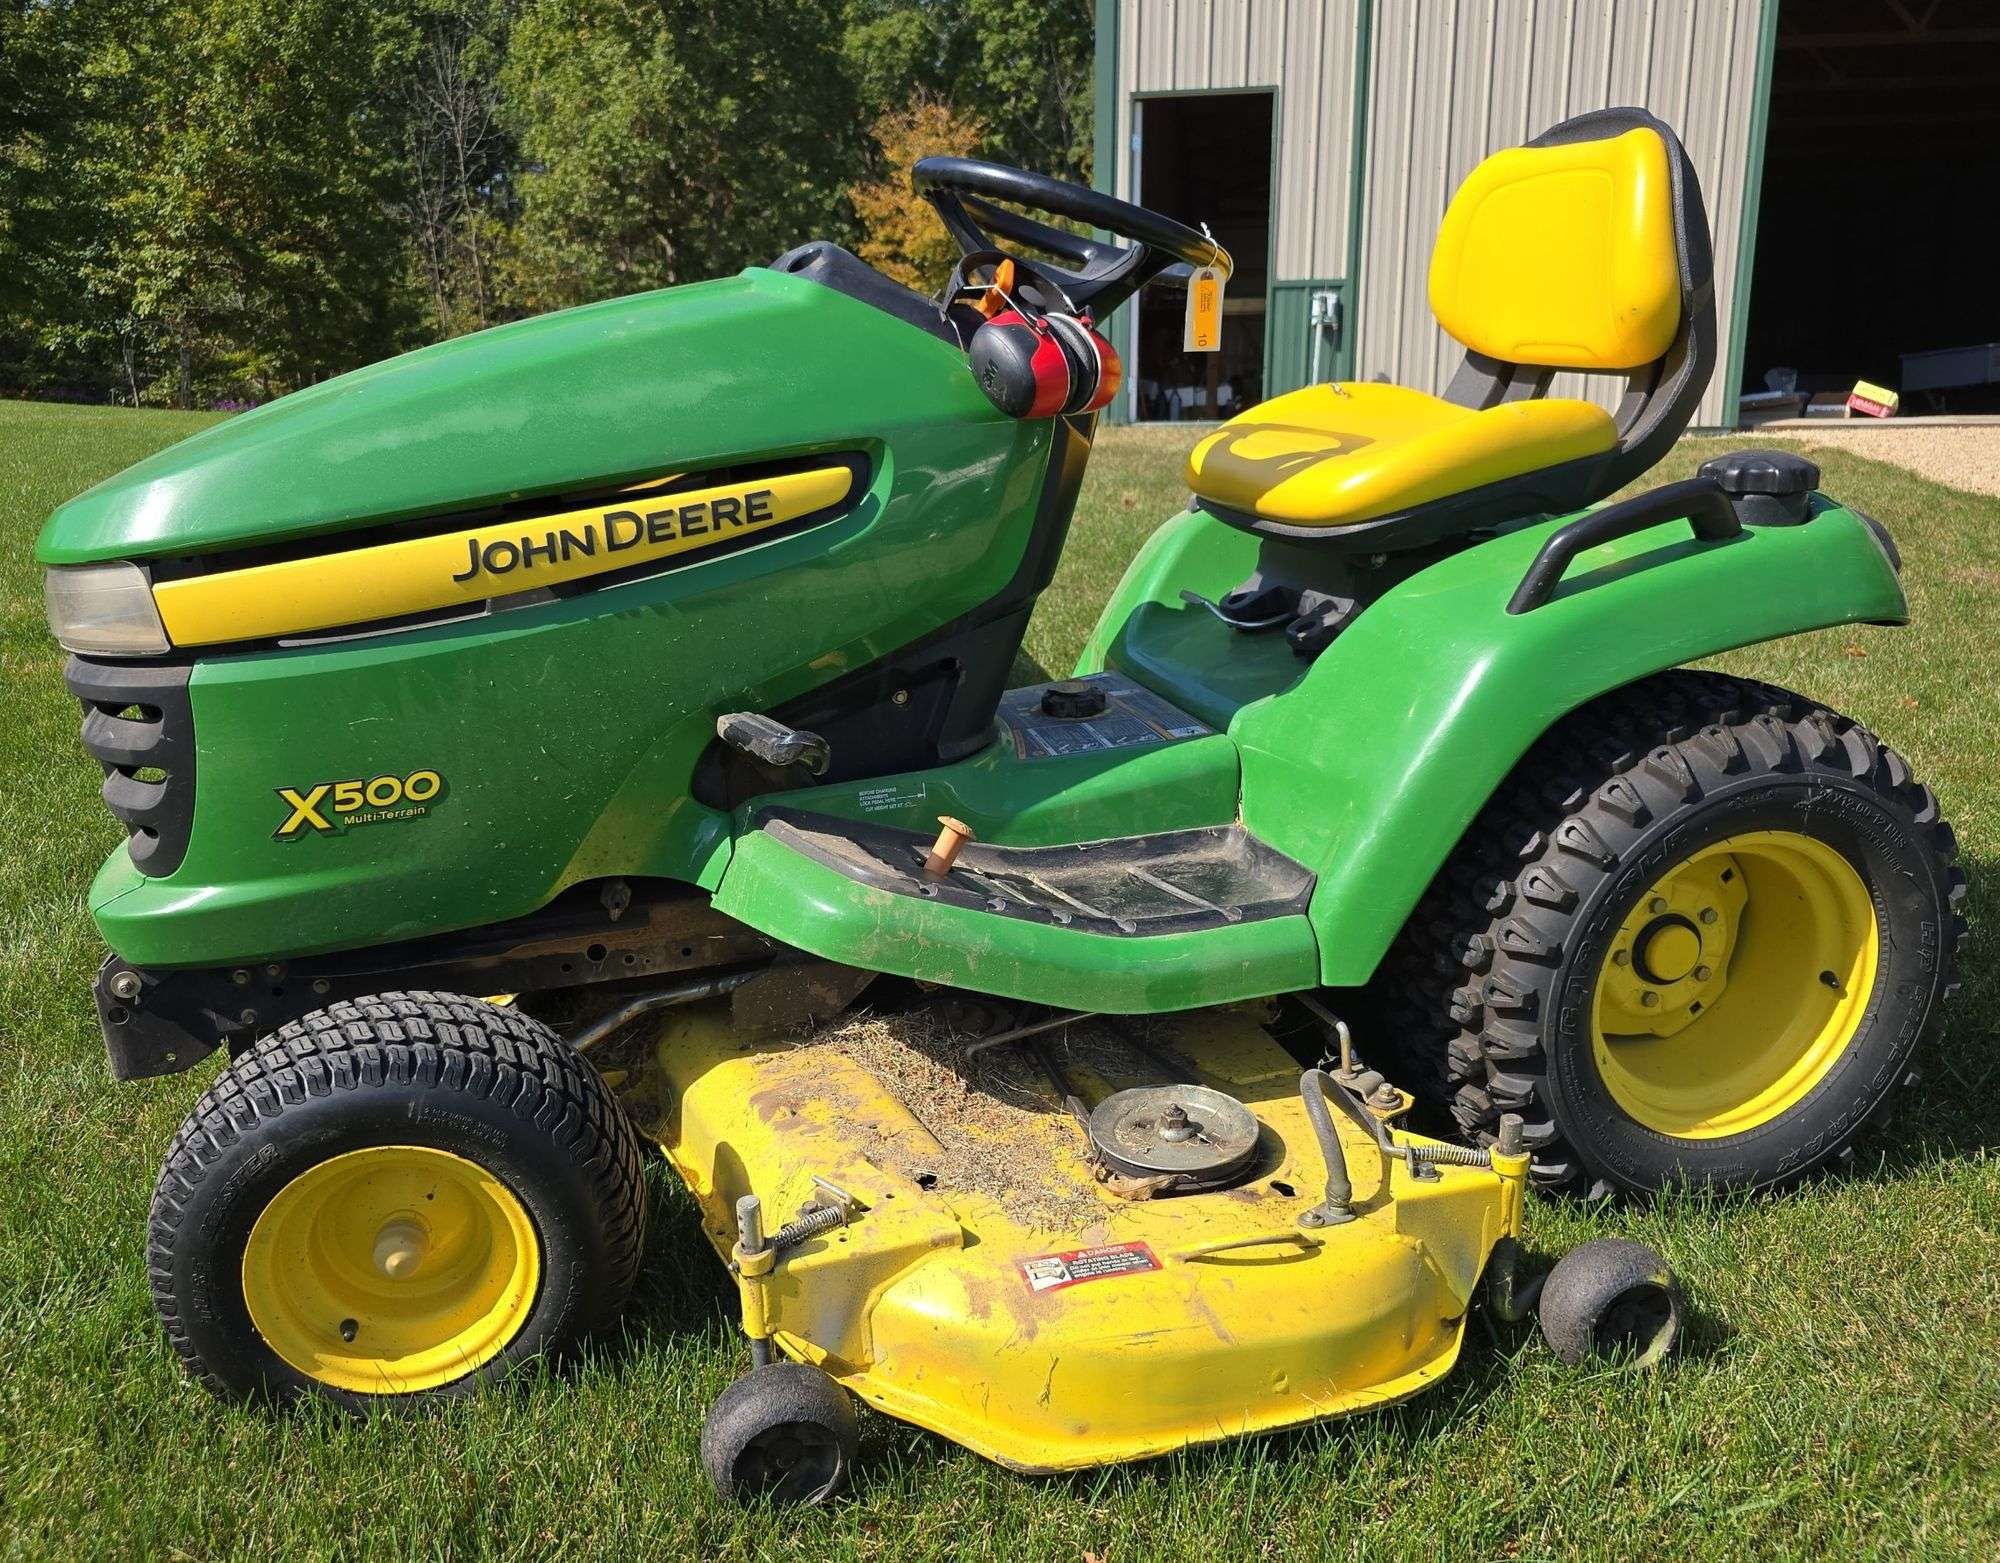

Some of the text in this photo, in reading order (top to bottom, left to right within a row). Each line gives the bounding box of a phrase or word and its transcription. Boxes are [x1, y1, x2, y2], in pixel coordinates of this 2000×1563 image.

[453, 489, 774, 582] JOHN DEERE
[276, 769, 442, 835] X500
[344, 806, 426, 825] Multi-Terrain
